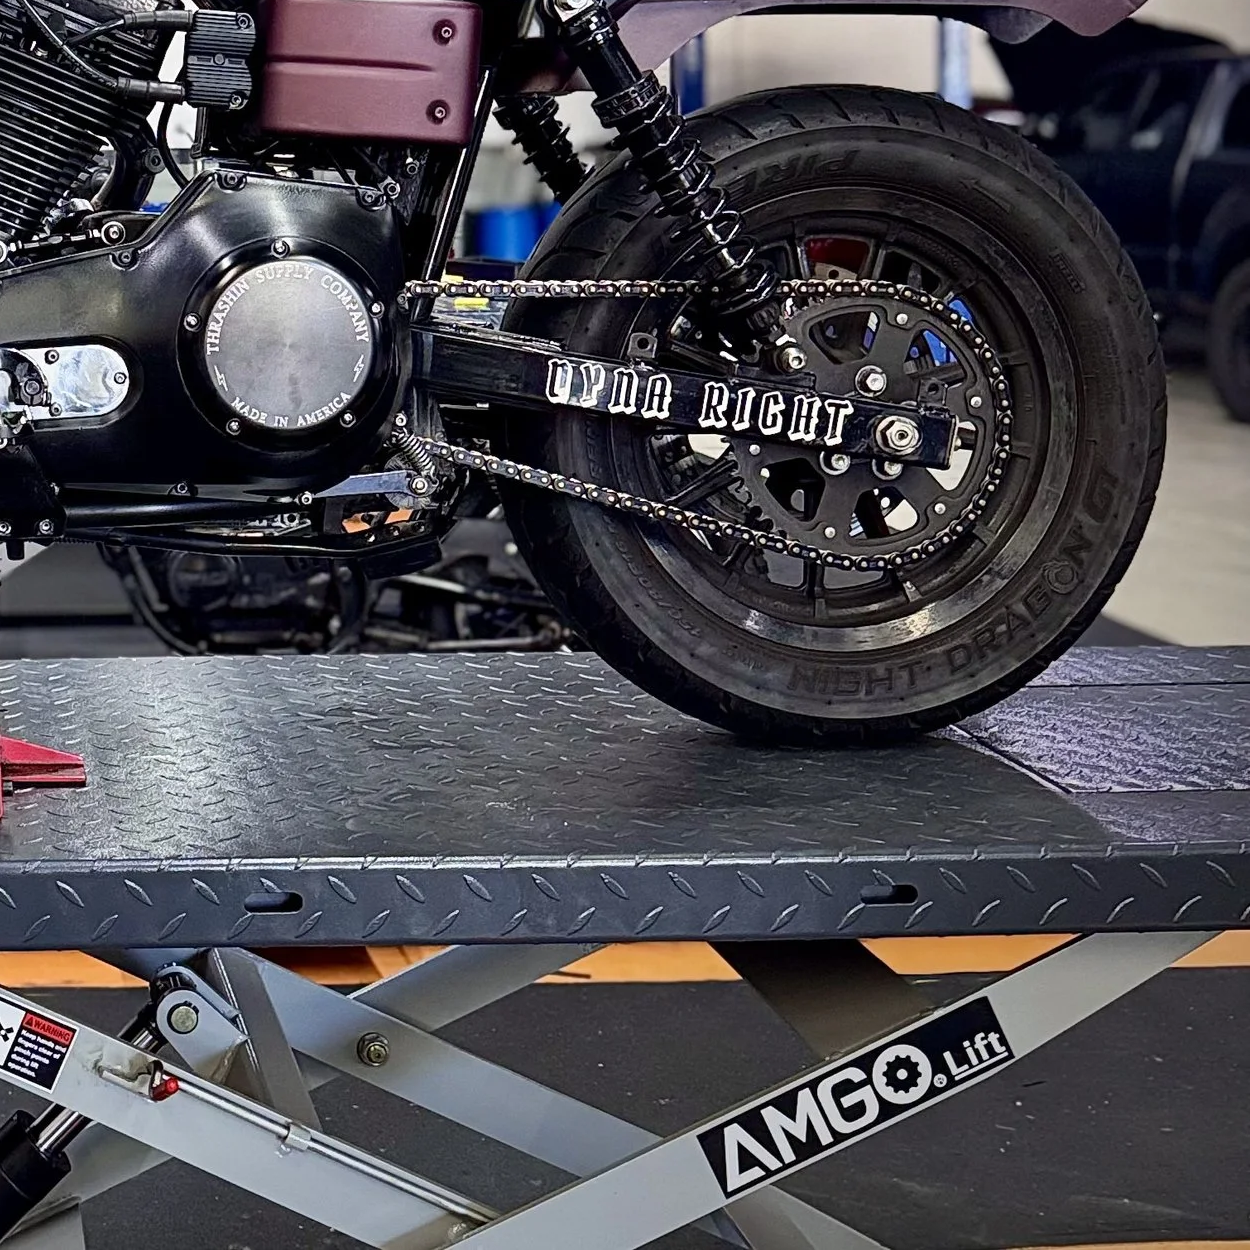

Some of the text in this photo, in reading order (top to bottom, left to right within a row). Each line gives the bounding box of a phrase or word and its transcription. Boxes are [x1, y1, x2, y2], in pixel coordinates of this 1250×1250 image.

[206, 264, 369, 355] THRASHIN SUPPLY COMPANY
[231, 391, 352, 427] MADE IN AMERICA
[546, 358, 854, 447] DYNA RIGHT
[787, 660, 924, 697] NIGHT
[948, 522, 1094, 673] DRAGON
[21, 1029, 37, 1041] Keep
[33, 1018, 71, 1042] WARNING
[943, 1031, 1007, 1076] Lift
